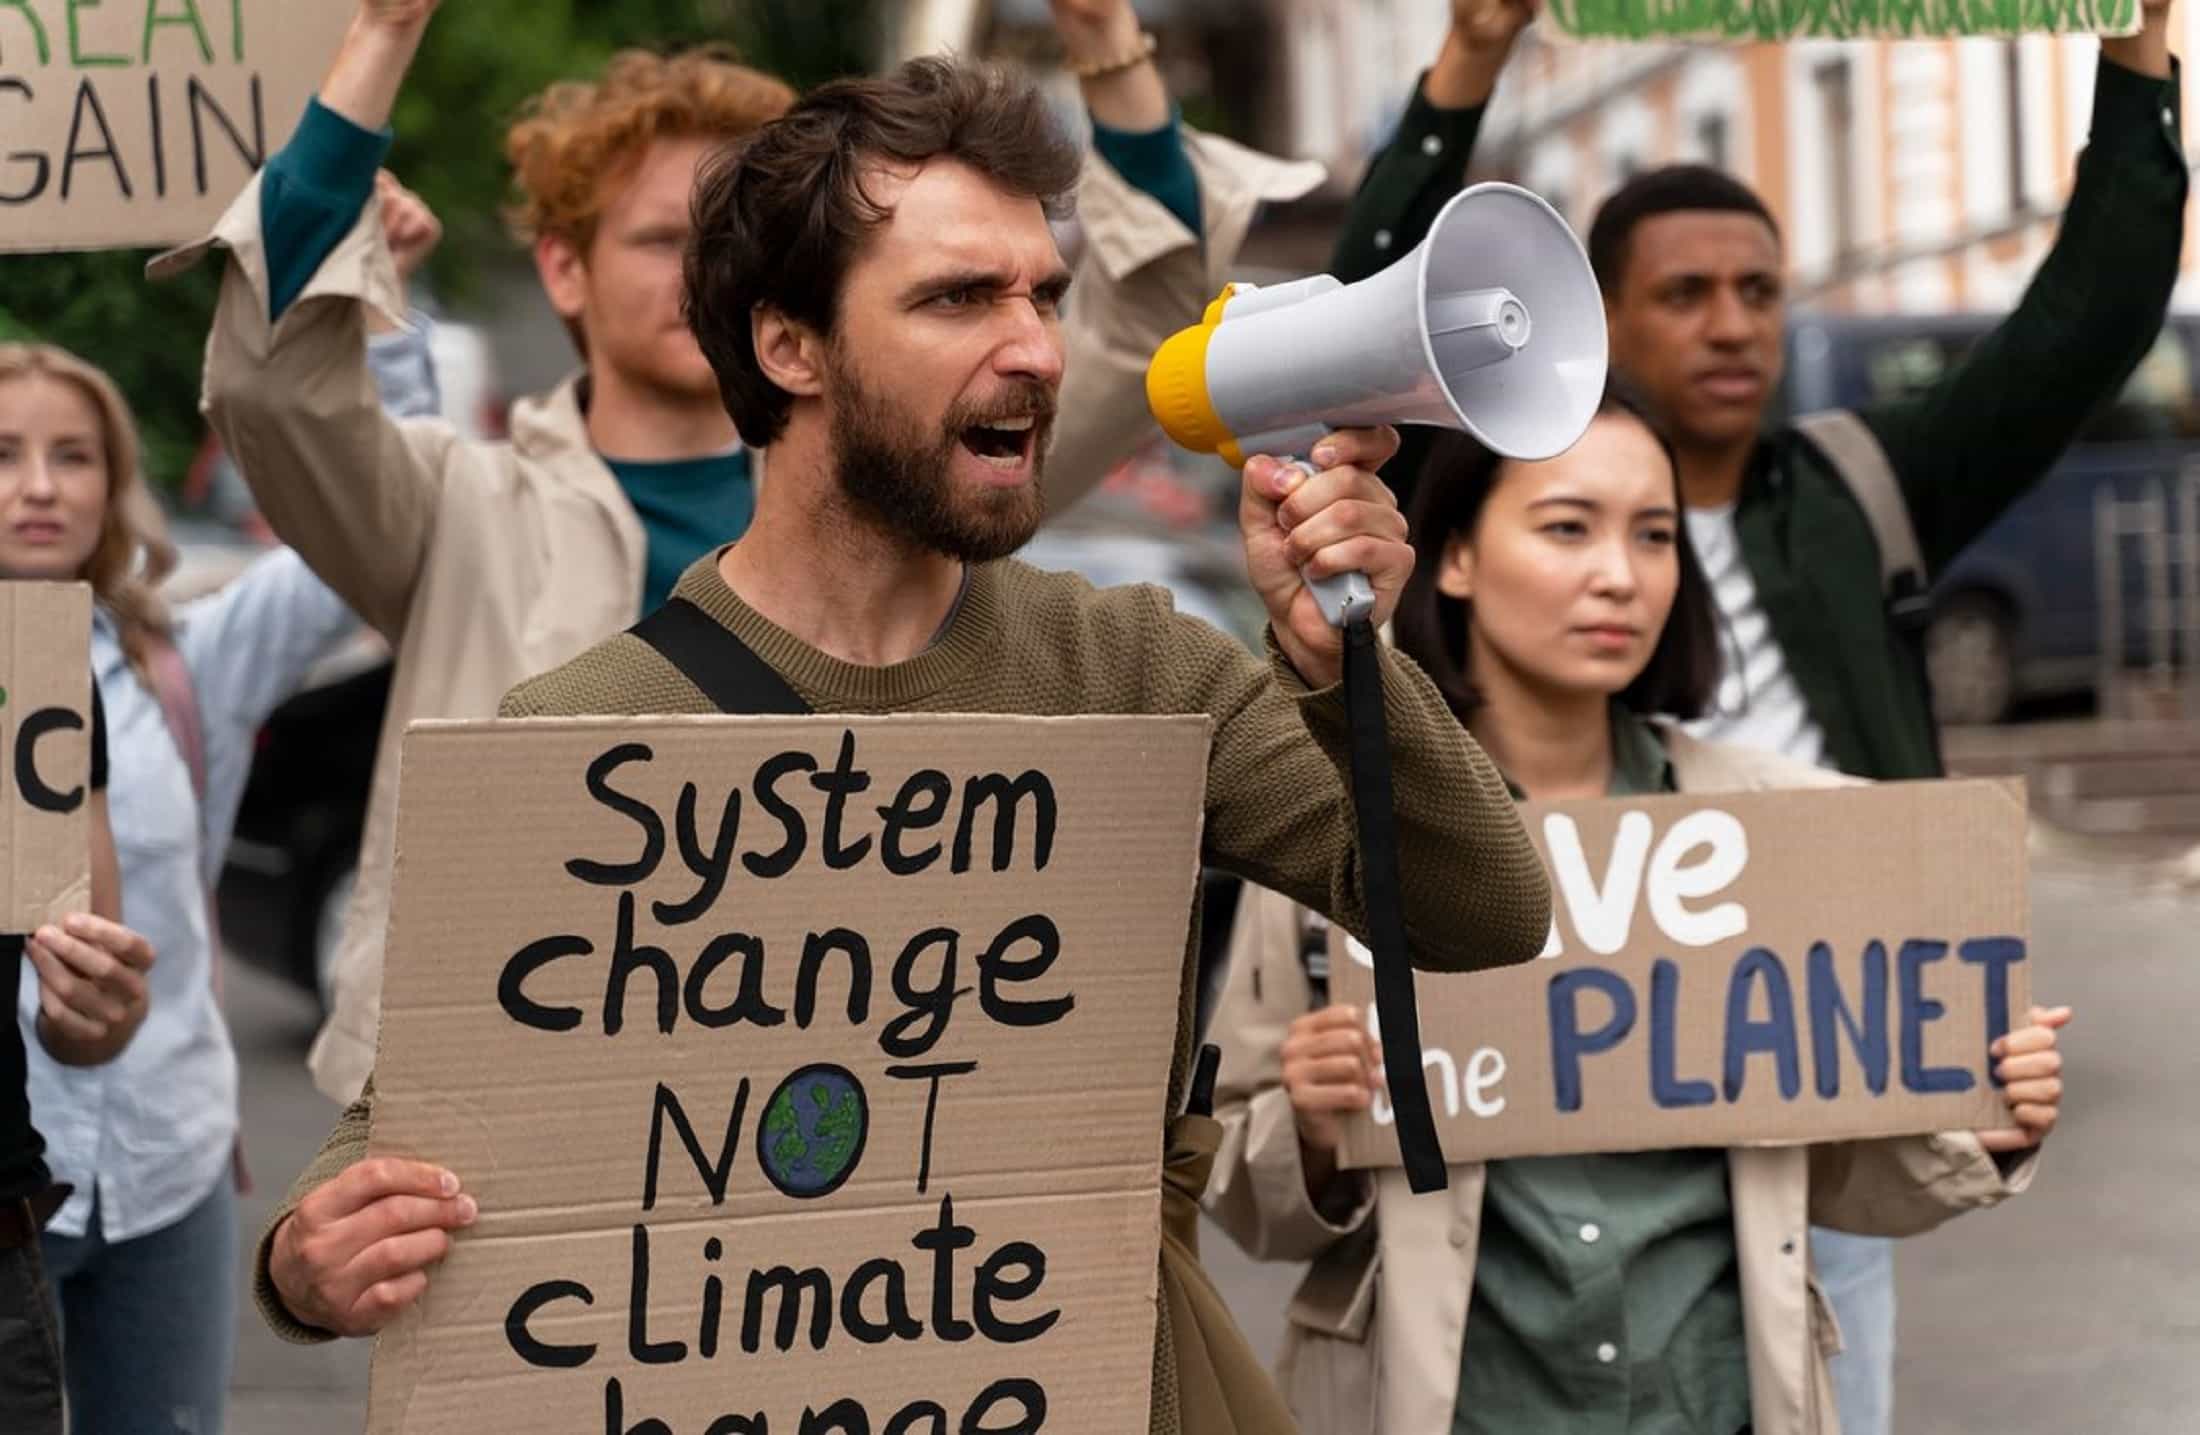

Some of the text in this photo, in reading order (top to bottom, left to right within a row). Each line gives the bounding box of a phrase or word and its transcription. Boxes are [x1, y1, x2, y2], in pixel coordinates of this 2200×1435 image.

[564, 729, 1058, 926] System
[497, 890, 1075, 1059] change
[1547, 936, 2027, 1112] PLANET
[641, 1060, 979, 1211] NOT
